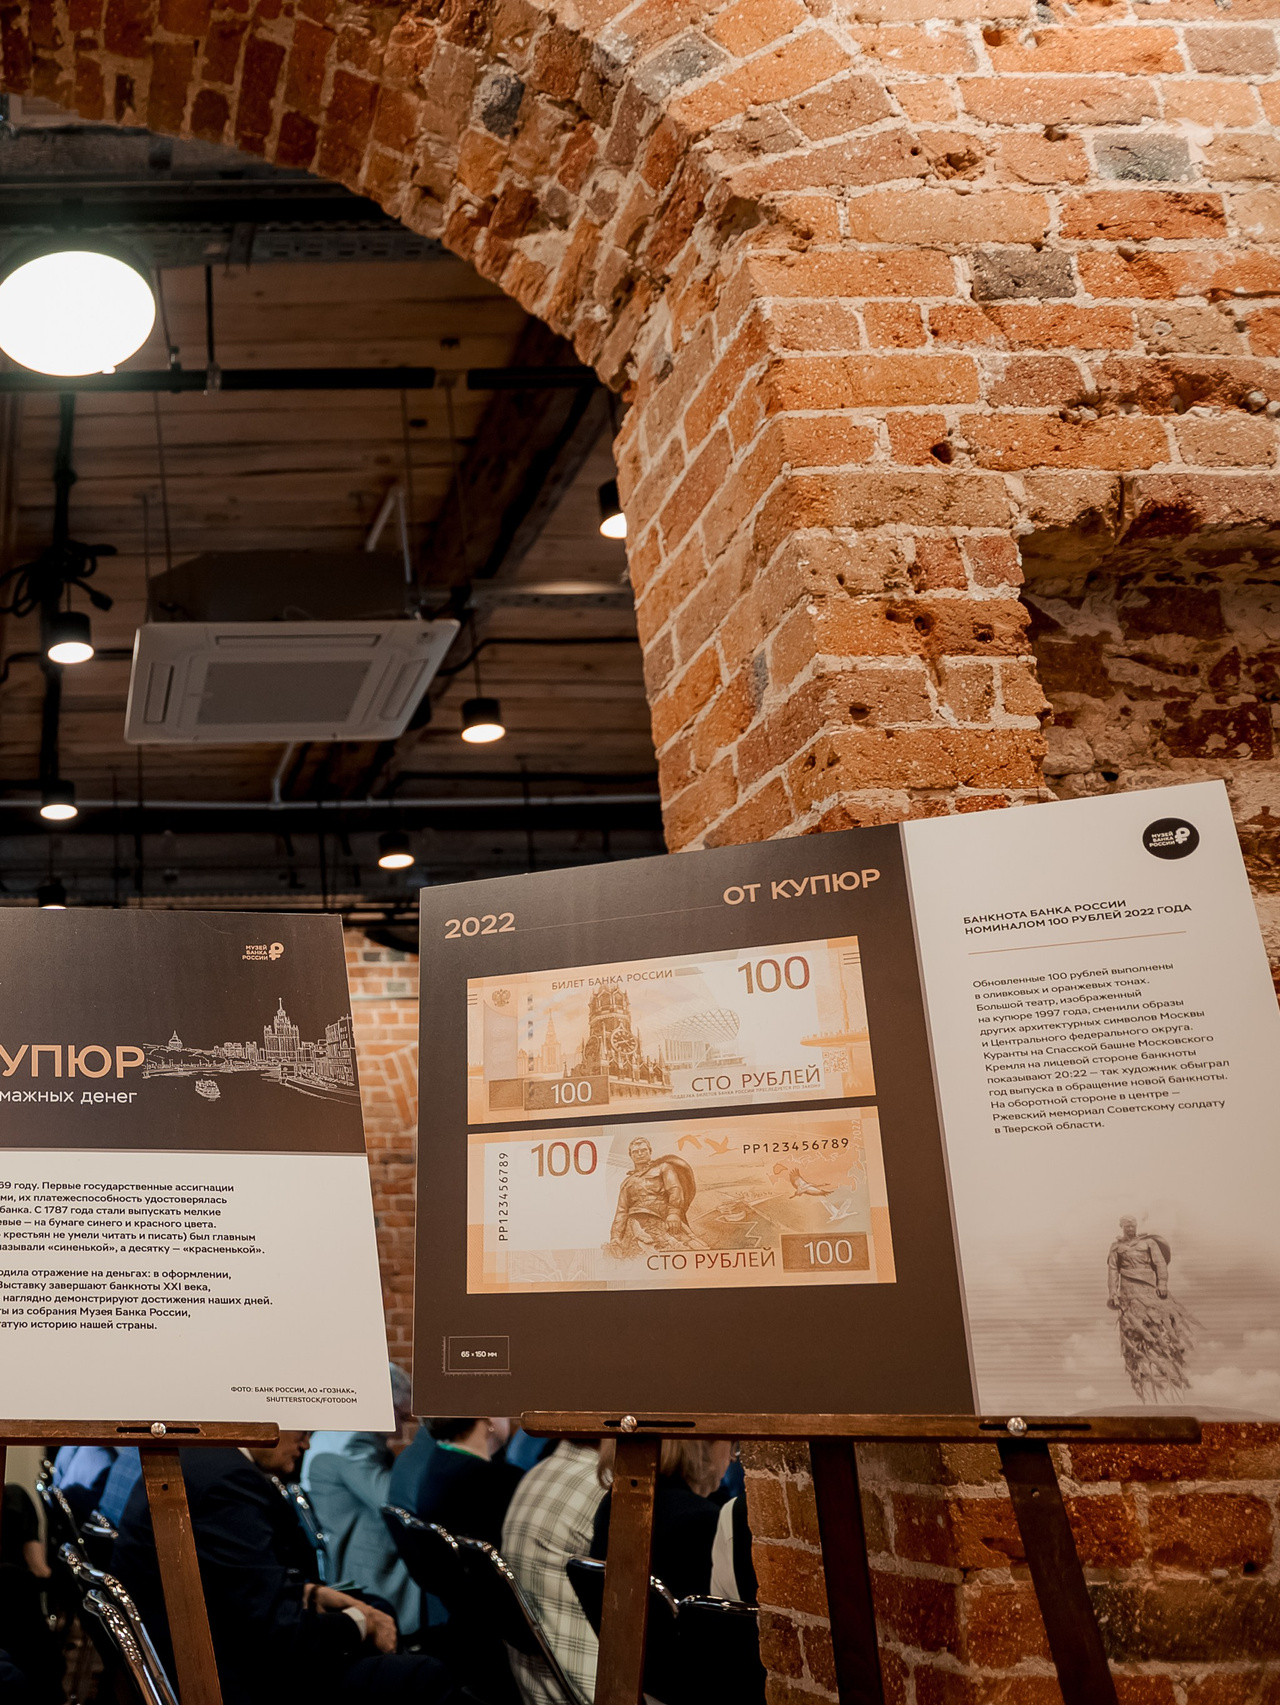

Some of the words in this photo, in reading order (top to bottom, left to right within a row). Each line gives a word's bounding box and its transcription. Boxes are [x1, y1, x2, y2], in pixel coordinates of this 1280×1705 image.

[723, 883, 761, 905] ОТ
[771, 868, 881, 900] КУПЮР
[963, 910, 1028, 925] БАНКНОТА
[1029, 905, 1072, 918] БАНКА
[1073, 899, 1127, 913] РОССИИ
[964, 919, 1046, 935] НОМИНАЛОМ
[1047, 916, 1069, 926] 100
[1071, 910, 1122, 924] РУБЛЕЙ
[1123, 907, 1155, 918] 2022
[1156, 903, 1193, 915] ГОДА
[444, 912, 516, 940] 2022
[551, 978, 585, 991] БИЛЕТ
[588, 975, 624, 987] БАНКА
[626, 969, 673, 983] РОССИИ
[737, 955, 810, 995] 100
[972, 975, 1046, 988] Обновленные
[1047, 971, 1068, 981] 100
[1069, 967, 1109, 981] рублей
[1110, 963, 1174, 975] выполнены
[975, 999, 1024, 1012] Большой
[1024, 998, 1059, 1007] театр,
[1059, 988, 1142, 1004] изображенный
[977, 1016, 991, 1024] на
[992, 1012, 1033, 1024] купюре
[1034, 1008, 1061, 1018] 1997
[1062, 1008, 1091, 1016] года,
[1091, 1003, 1140, 1014] сменили
[1141, 999, 1185, 1010] образы
[979, 1026, 1017, 1037] других
[1018, 1019, 1102, 1034] архитектурных
[1102, 1014, 1158, 1025] символов
[1159, 1010, 1205, 1021] Москвы
[983, 1050, 1029, 1061] Куранты
[1030, 1048, 1044, 1056] на
[1045, 1042, 1098, 1055] Спасской
[1099, 1041, 1136, 1051] башне
[1137, 1035, 1214, 1048] Московского
[691, 1075, 731, 1092] СТО
[741, 1064, 821, 1089] РУБЛЕЙ
[80, 1091, 138, 1105] денег
[550, 1080, 592, 1104] 100
[1002, 1122, 1054, 1135] Тверской
[1055, 1120, 1105, 1131] области.
[531, 1139, 598, 1177] 100
[13, 1182, 40, 1192] году.
[41, 1181, 82, 1192] Первые
[83, 1183, 173, 1193] государственные
[174, 1184, 235, 1193] ассигнации
[18, 1194, 31, 1202] их
[33, 1193, 143, 1203] платежеспособность
[143, 1196, 228, 1206] удостоверялась
[646, 1254, 687, 1271] СТО
[695, 1247, 776, 1270] РУБЛЕЙ
[803, 1239, 853, 1265] 100
[2, 1295, 52, 1304] наглядно
[53, 1295, 139, 1306] демонстрируют
[140, 1296, 206, 1305] достижения
[207, 1297, 242, 1305] наших
[243, 1295, 273, 1306] дней.
[266, 1396, 358, 1404] SHUTTERSTOCK/FOTODOM
